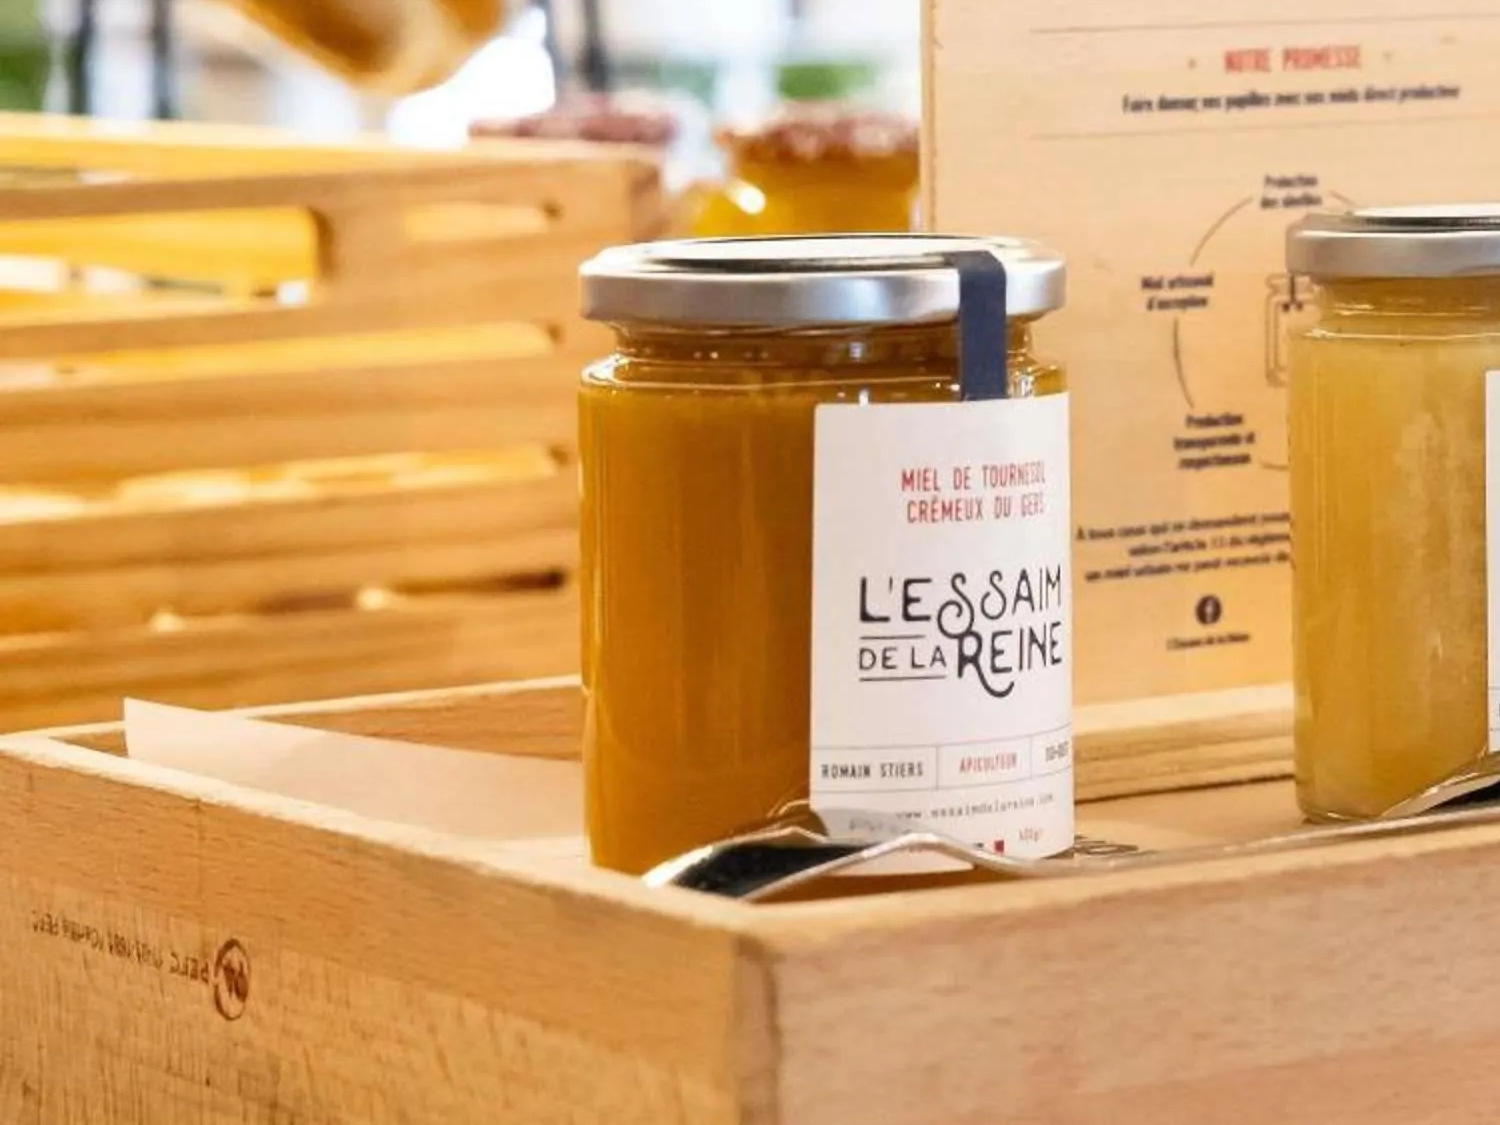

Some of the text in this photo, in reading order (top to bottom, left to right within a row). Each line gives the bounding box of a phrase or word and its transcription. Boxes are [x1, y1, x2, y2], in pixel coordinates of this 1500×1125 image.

[1224, 45, 1362, 74] NOTRE PROMESSE
[901, 459, 1046, 492] MIEL DE TOURNESOL
[906, 494, 984, 523] CRÉMEUX
[995, 495, 1012, 519] DU
[859, 563, 1062, 637] L'ESSAIM
[858, 622, 1063, 699] DE LA REINE
[820, 761, 925, 780] ROMAIN STIERS
[958, 751, 1018, 774] APICULTEUR
